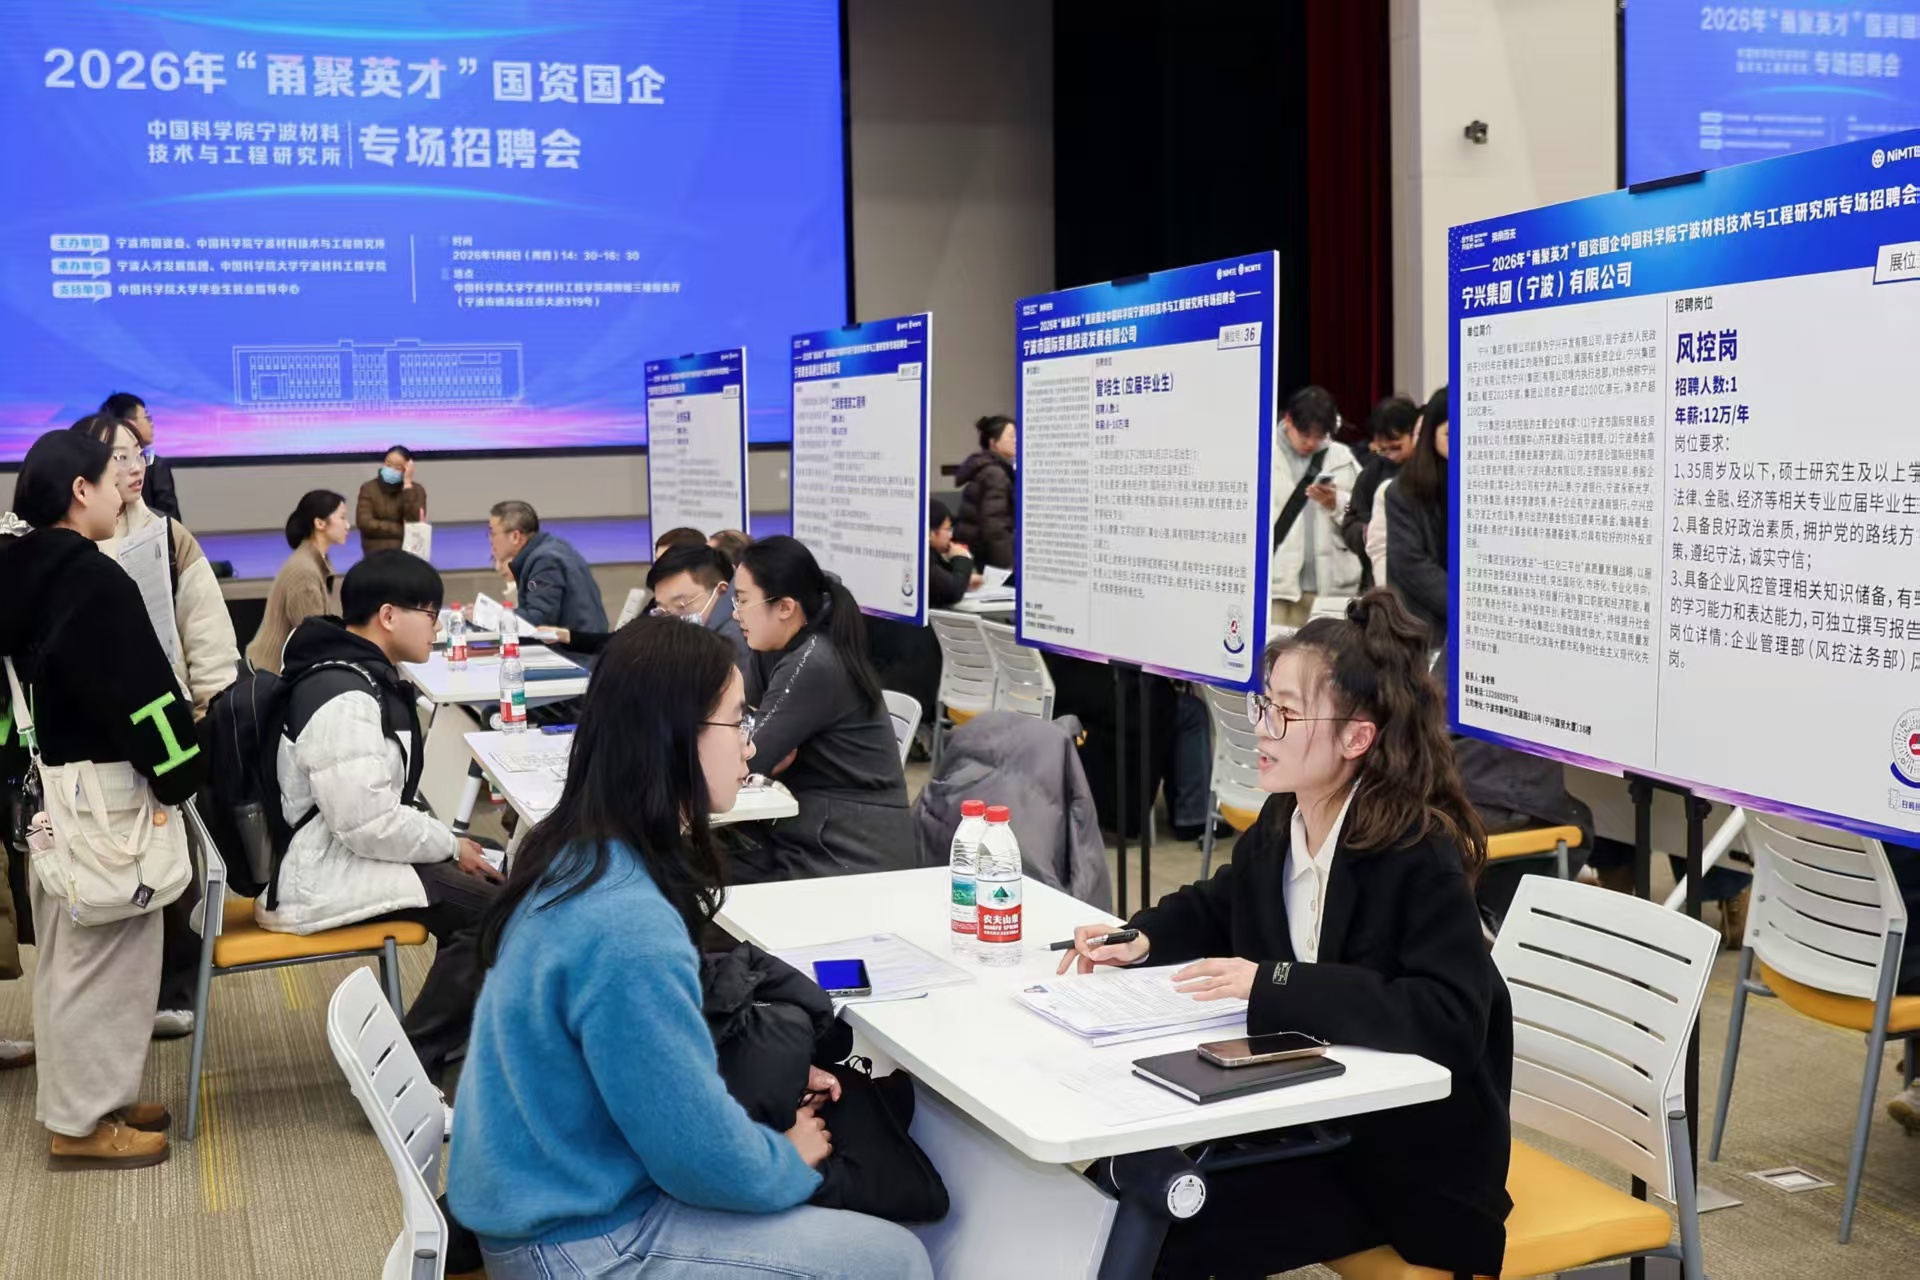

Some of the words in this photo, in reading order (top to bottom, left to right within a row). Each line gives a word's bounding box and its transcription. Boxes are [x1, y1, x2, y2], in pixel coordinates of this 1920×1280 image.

[148, 119, 340, 142] 中国科学院宁波材料
[148, 143, 341, 166] 技术与工程研究所
[358, 123, 581, 169] 专场招聘会
[1675, 296, 1713, 313] 招聘岗位
[1244, 327, 1255, 341] 36
[1467, 324, 1492, 337] 单位简介
[1675, 328, 1738, 364] 风控岗
[983, 913, 1019, 924] 农夫山泉
